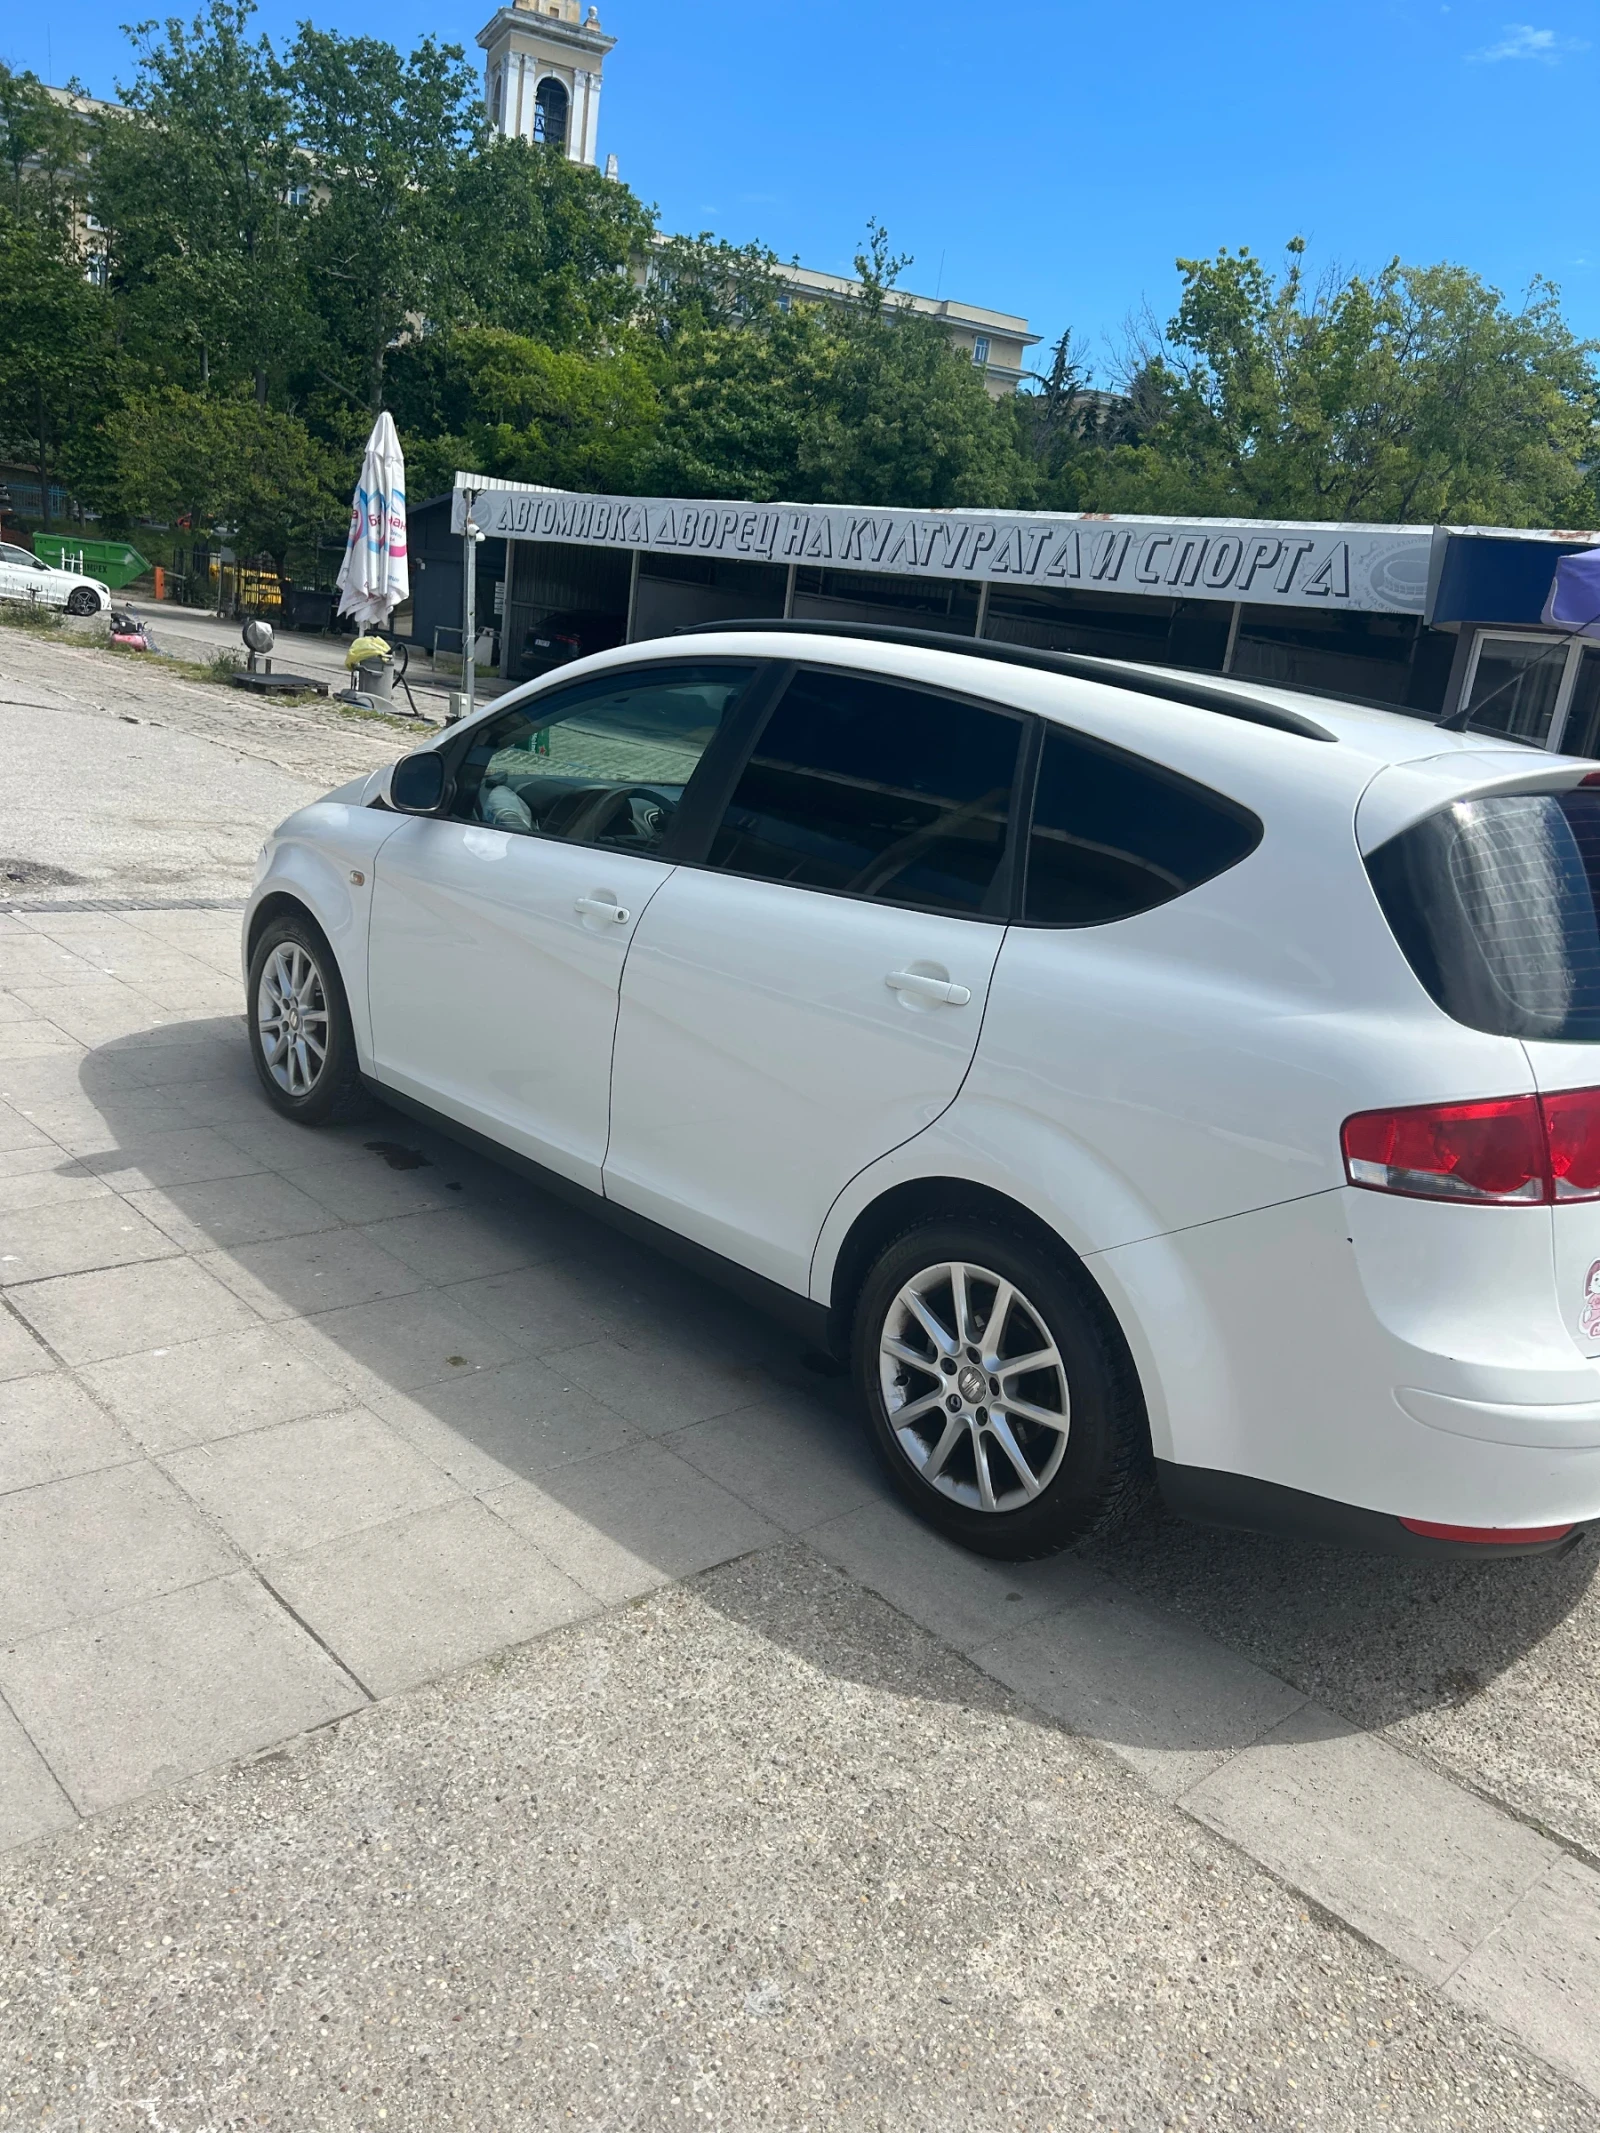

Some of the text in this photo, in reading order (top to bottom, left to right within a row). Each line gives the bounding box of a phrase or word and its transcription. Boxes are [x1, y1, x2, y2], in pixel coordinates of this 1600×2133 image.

[496, 496, 1351, 598] АВТОМИВКА ДВОРЕЦ НА КУЛТУРАТА И СПОРТА
